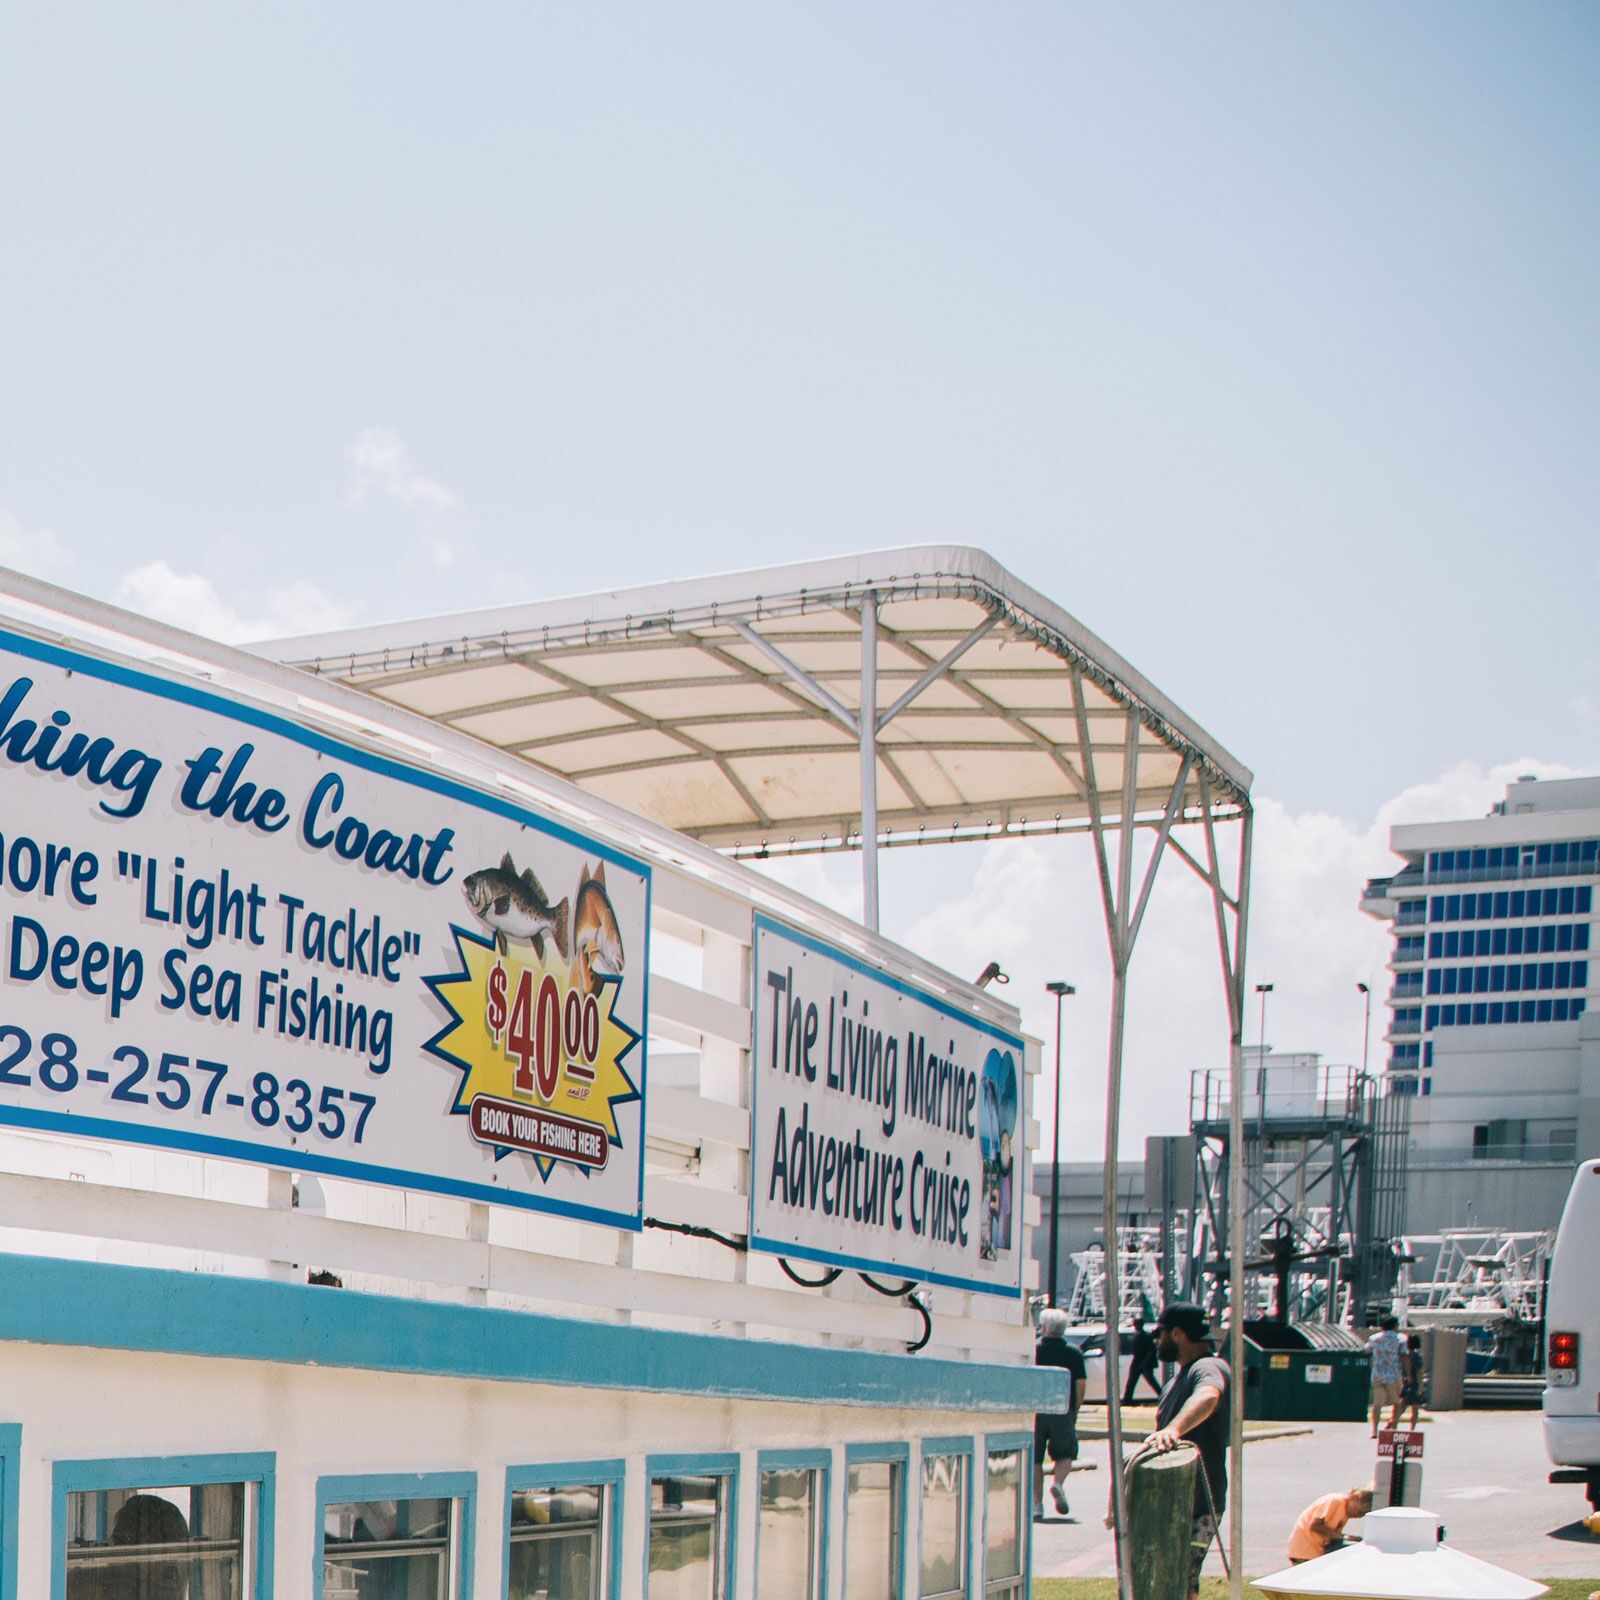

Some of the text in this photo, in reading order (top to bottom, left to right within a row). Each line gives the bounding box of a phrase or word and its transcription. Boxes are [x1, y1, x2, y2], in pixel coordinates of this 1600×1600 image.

[181, 743, 290, 832] the
[303, 772, 454, 885] Coast
[118, 850, 266, 949] "Light
[279, 893, 421, 983] Tackle"
[10, 915, 144, 1018] Deep
[160, 949, 242, 1022] Sea
[258, 969, 393, 1073] Fishing
[767, 966, 976, 1139] The Living Marine
[481, 1106, 601, 1158] BOOK YOUR FISHING HERE
[769, 1102, 970, 1247] Adventure Cruise
[1393, 1433, 1409, 1442] DRY
